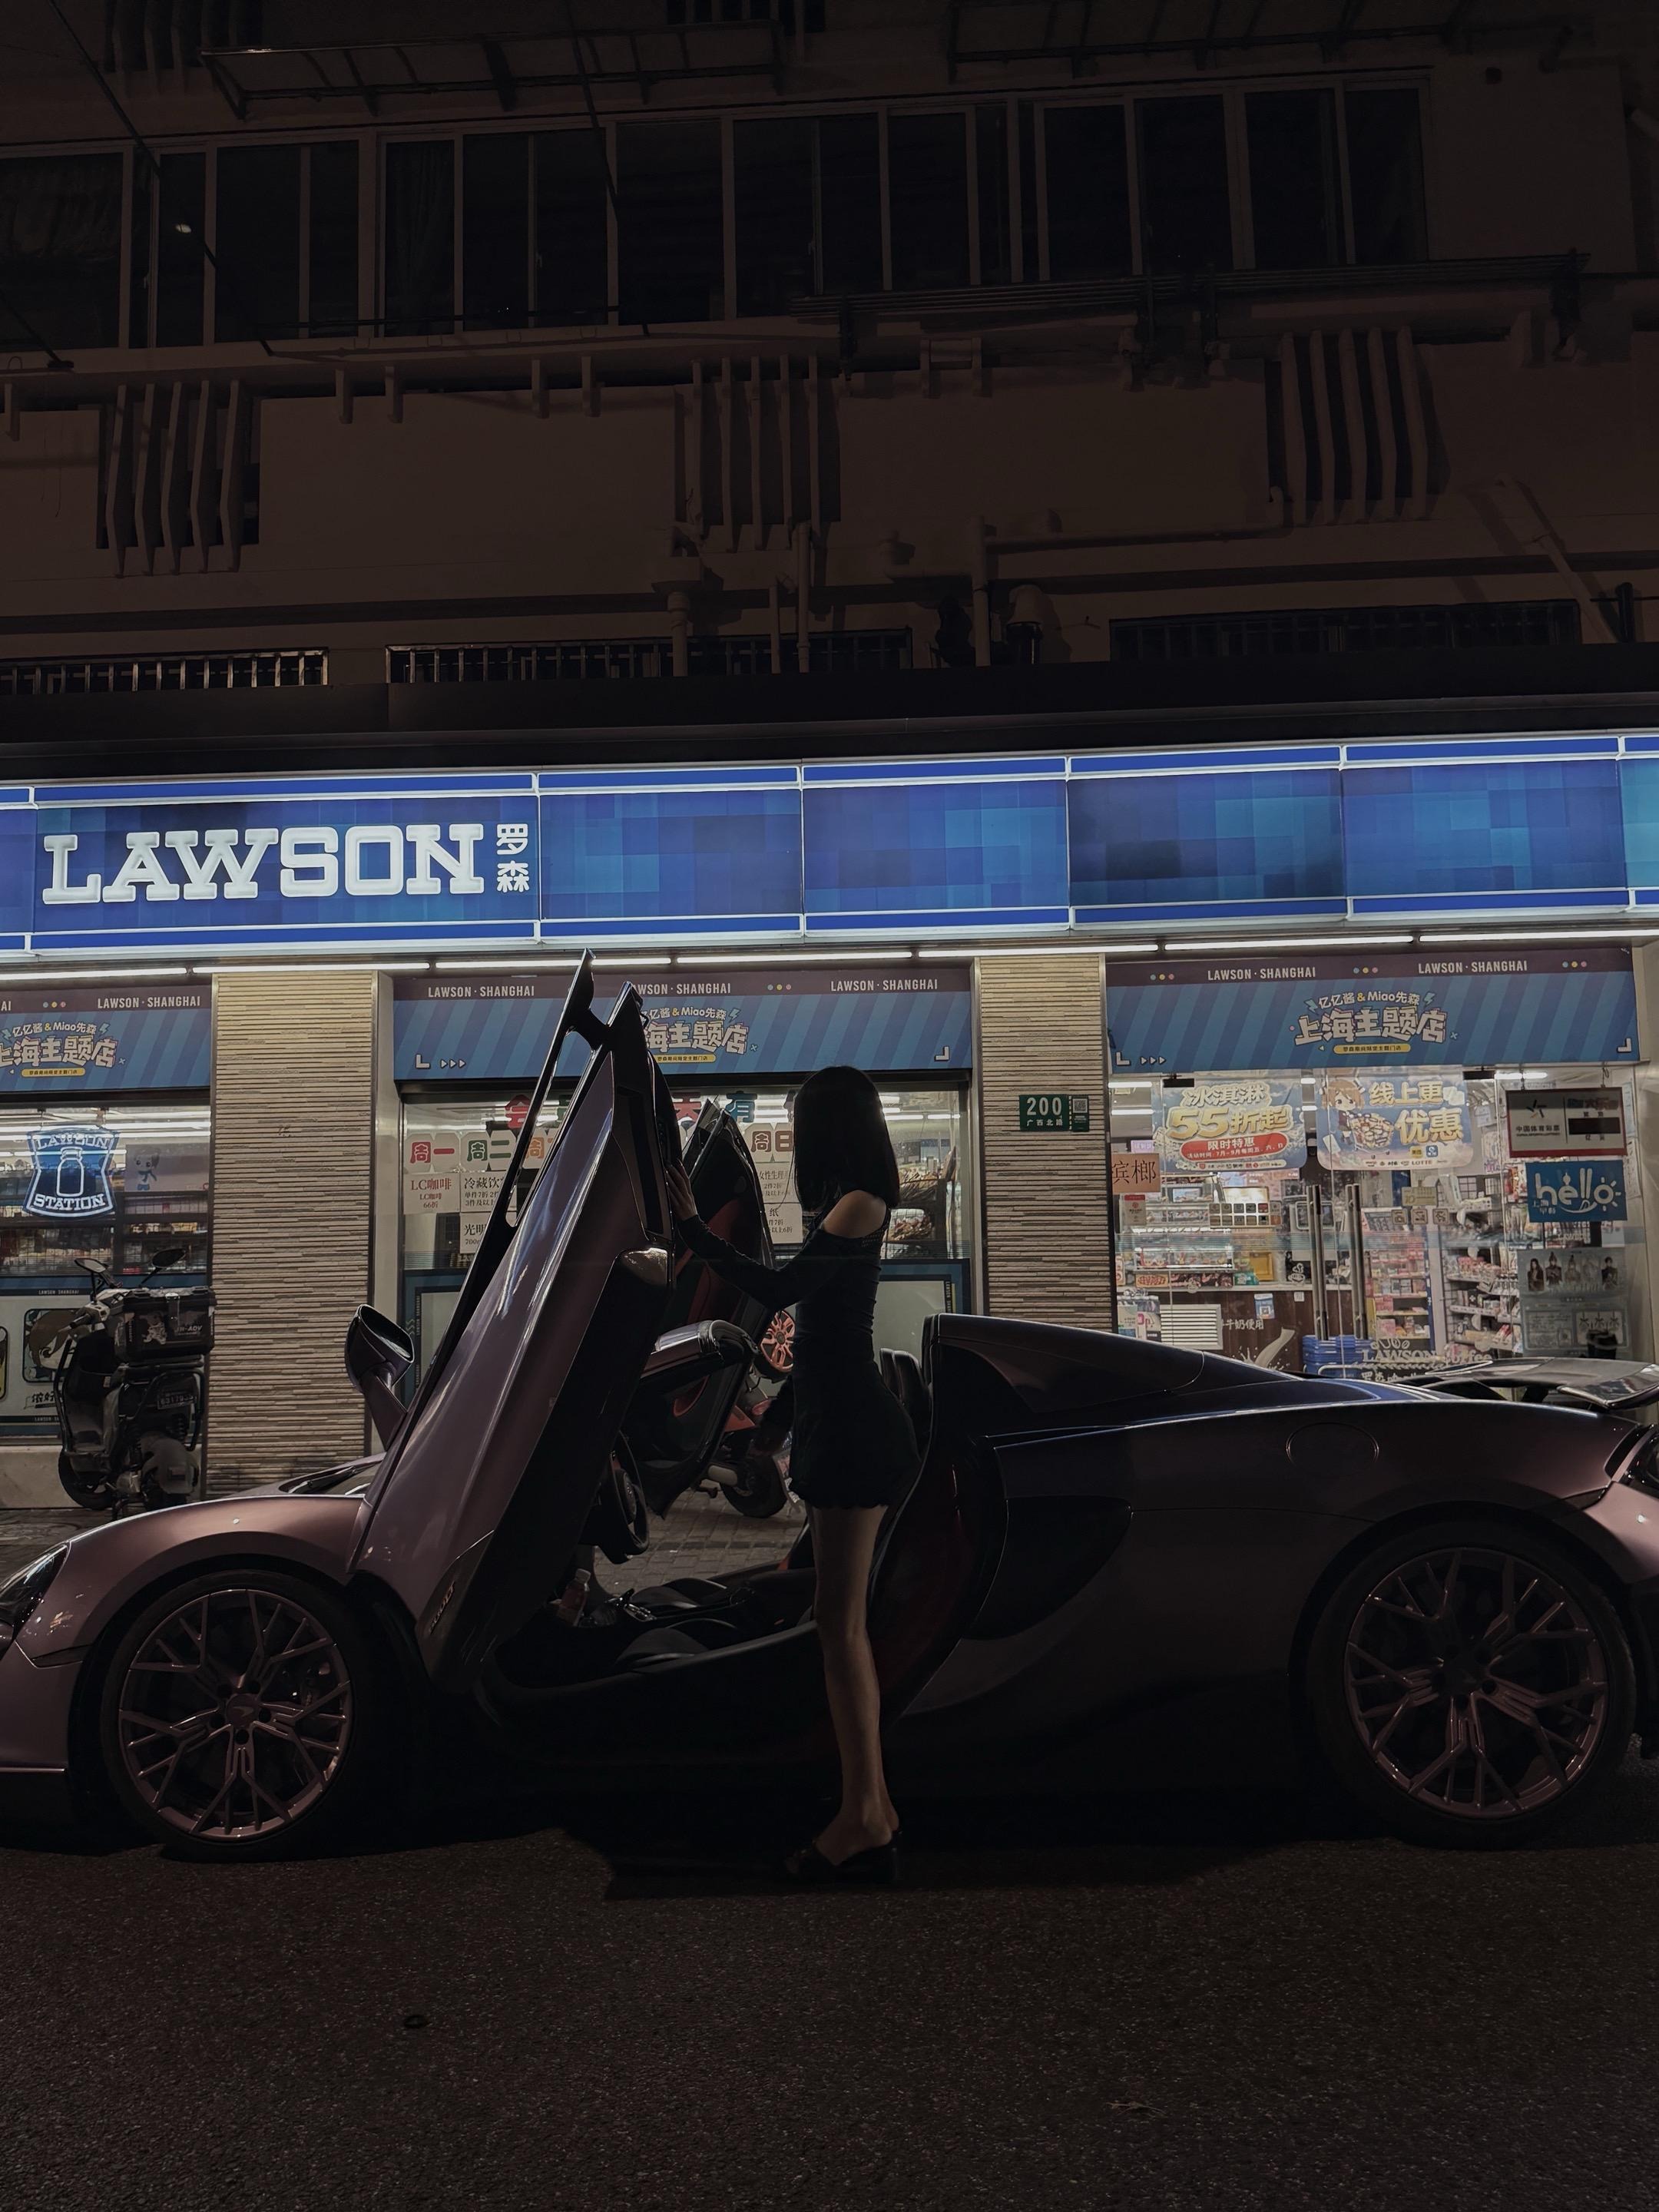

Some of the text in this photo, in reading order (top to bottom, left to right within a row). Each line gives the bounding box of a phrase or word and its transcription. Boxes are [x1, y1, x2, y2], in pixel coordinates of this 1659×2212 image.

[42, 824, 484, 905] LAWSON
[496, 823, 530, 892] 罗森
[1207, 967, 1316, 980] LAWSON SHANGHAI
[1419, 960, 1528, 974] LAWSON SHANGHAI
[428, 985, 535, 998] LAWSON SHANGHAI
[632, 982, 731, 995] WSON SHANGHAI
[830, 979, 938, 992] LAWSON SHANGHAI
[98, 996, 200, 1008] LAWSON SHANGHAI
[1294, 1007, 1448, 1045] 上海主题店
[645, 1021, 750, 1055] 海主题店
[1185, 1084, 1266, 1108] 冰淇淋
[1369, 1081, 1444, 1106] 线上更
[1027, 1097, 1061, 1116] 200
[1027, 1118, 1063, 1127] 广西北路
[1167, 1108, 1289, 1140] 55折起
[1394, 1108, 1463, 1144] 优惠
[35, 1133, 109, 1151] LAWSON
[751, 1131, 793, 1152] 周日
[1207, 1137, 1255, 1151] 限时特惠
[410, 1141, 455, 1164] 周一
[467, 1140, 512, 1162] 周二
[411, 1177, 452, 1190] LC咖啡
[465, 1177, 504, 1189] 冷藏饮
[1535, 1167, 1618, 1206] hello
[33, 1194, 106, 1211] STATION
[1221, 1318, 1264, 1330] 牛奶使用
[1363, 1349, 1438, 1363] LAWSON
